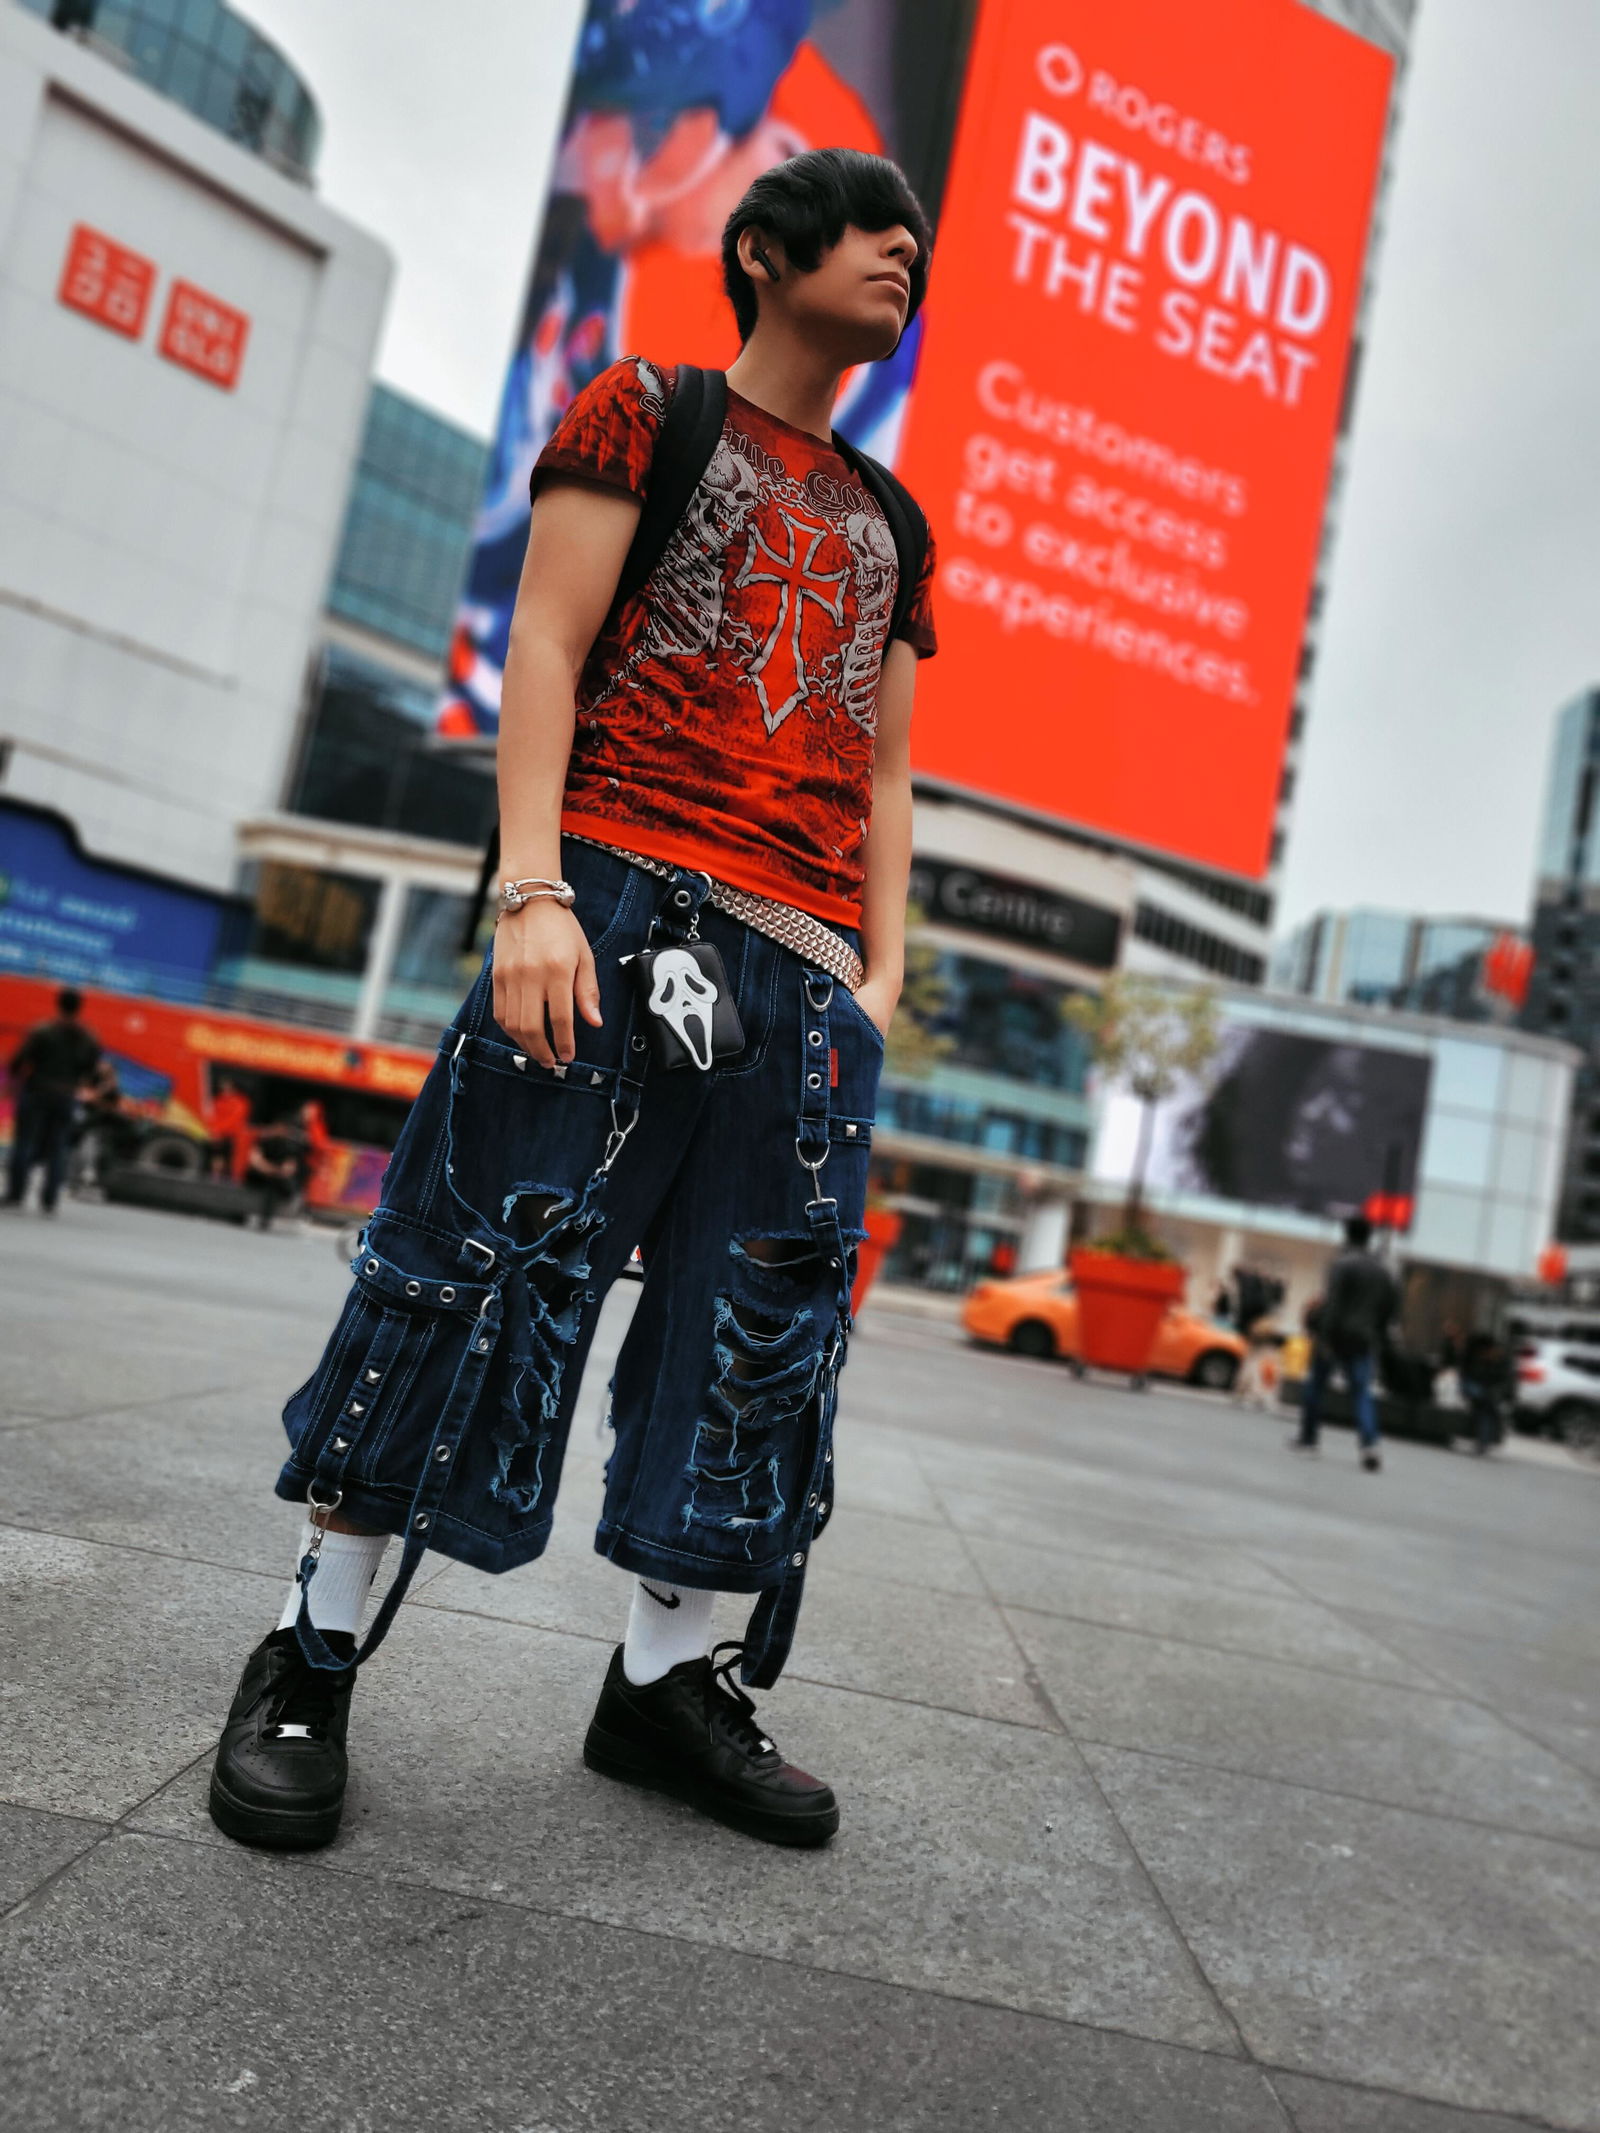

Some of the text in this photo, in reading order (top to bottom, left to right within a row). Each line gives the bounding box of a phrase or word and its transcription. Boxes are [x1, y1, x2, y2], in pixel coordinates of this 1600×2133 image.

[1087, 70, 1251, 184] ROGERS
[1014, 111, 1331, 337] BEYOND
[1006, 211, 1318, 409] THE SEAT
[964, 432, 1228, 571] get access
[976, 359, 1247, 518] Customers
[942, 556, 1261, 707] experiences.
[953, 489, 1250, 641] to exclusive
